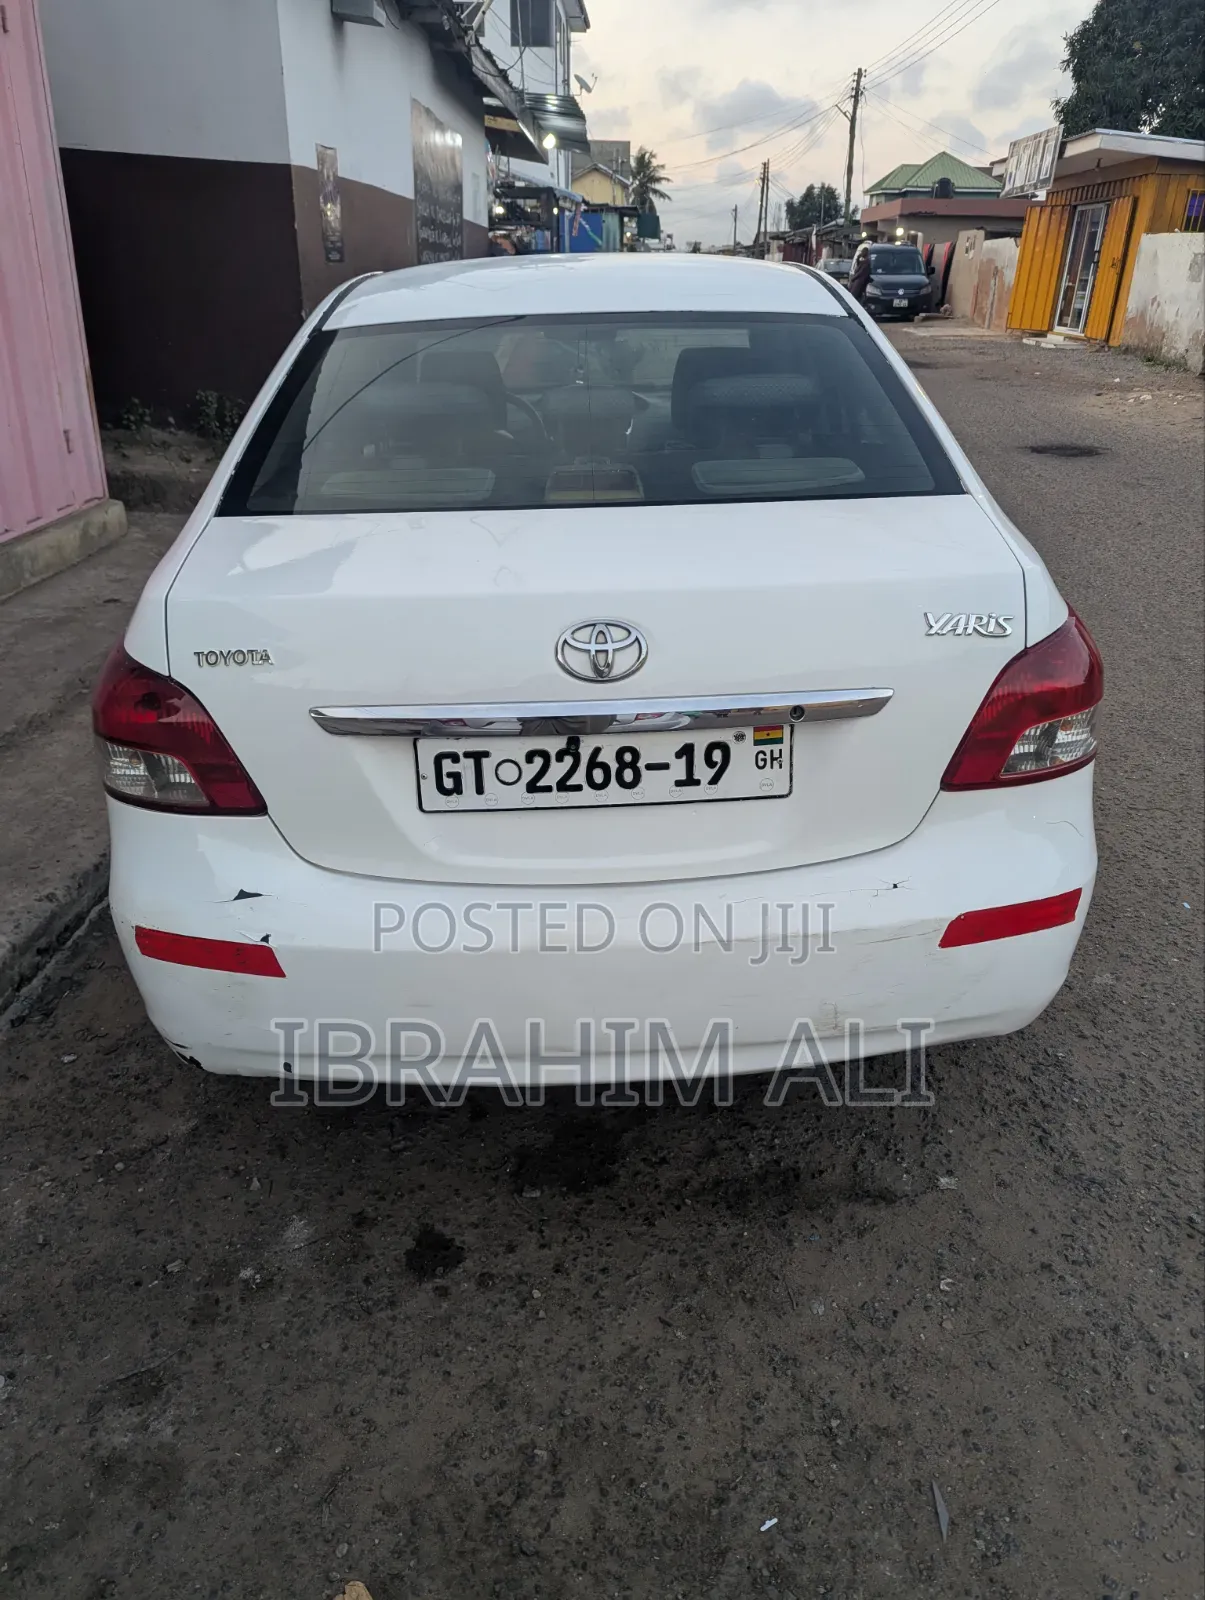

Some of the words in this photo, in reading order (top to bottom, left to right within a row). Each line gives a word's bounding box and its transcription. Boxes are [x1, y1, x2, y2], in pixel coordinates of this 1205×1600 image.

[193, 649, 274, 668] TOYOTA
[525, 741, 732, 795] 2268-19
[754, 748, 783, 770] GH
